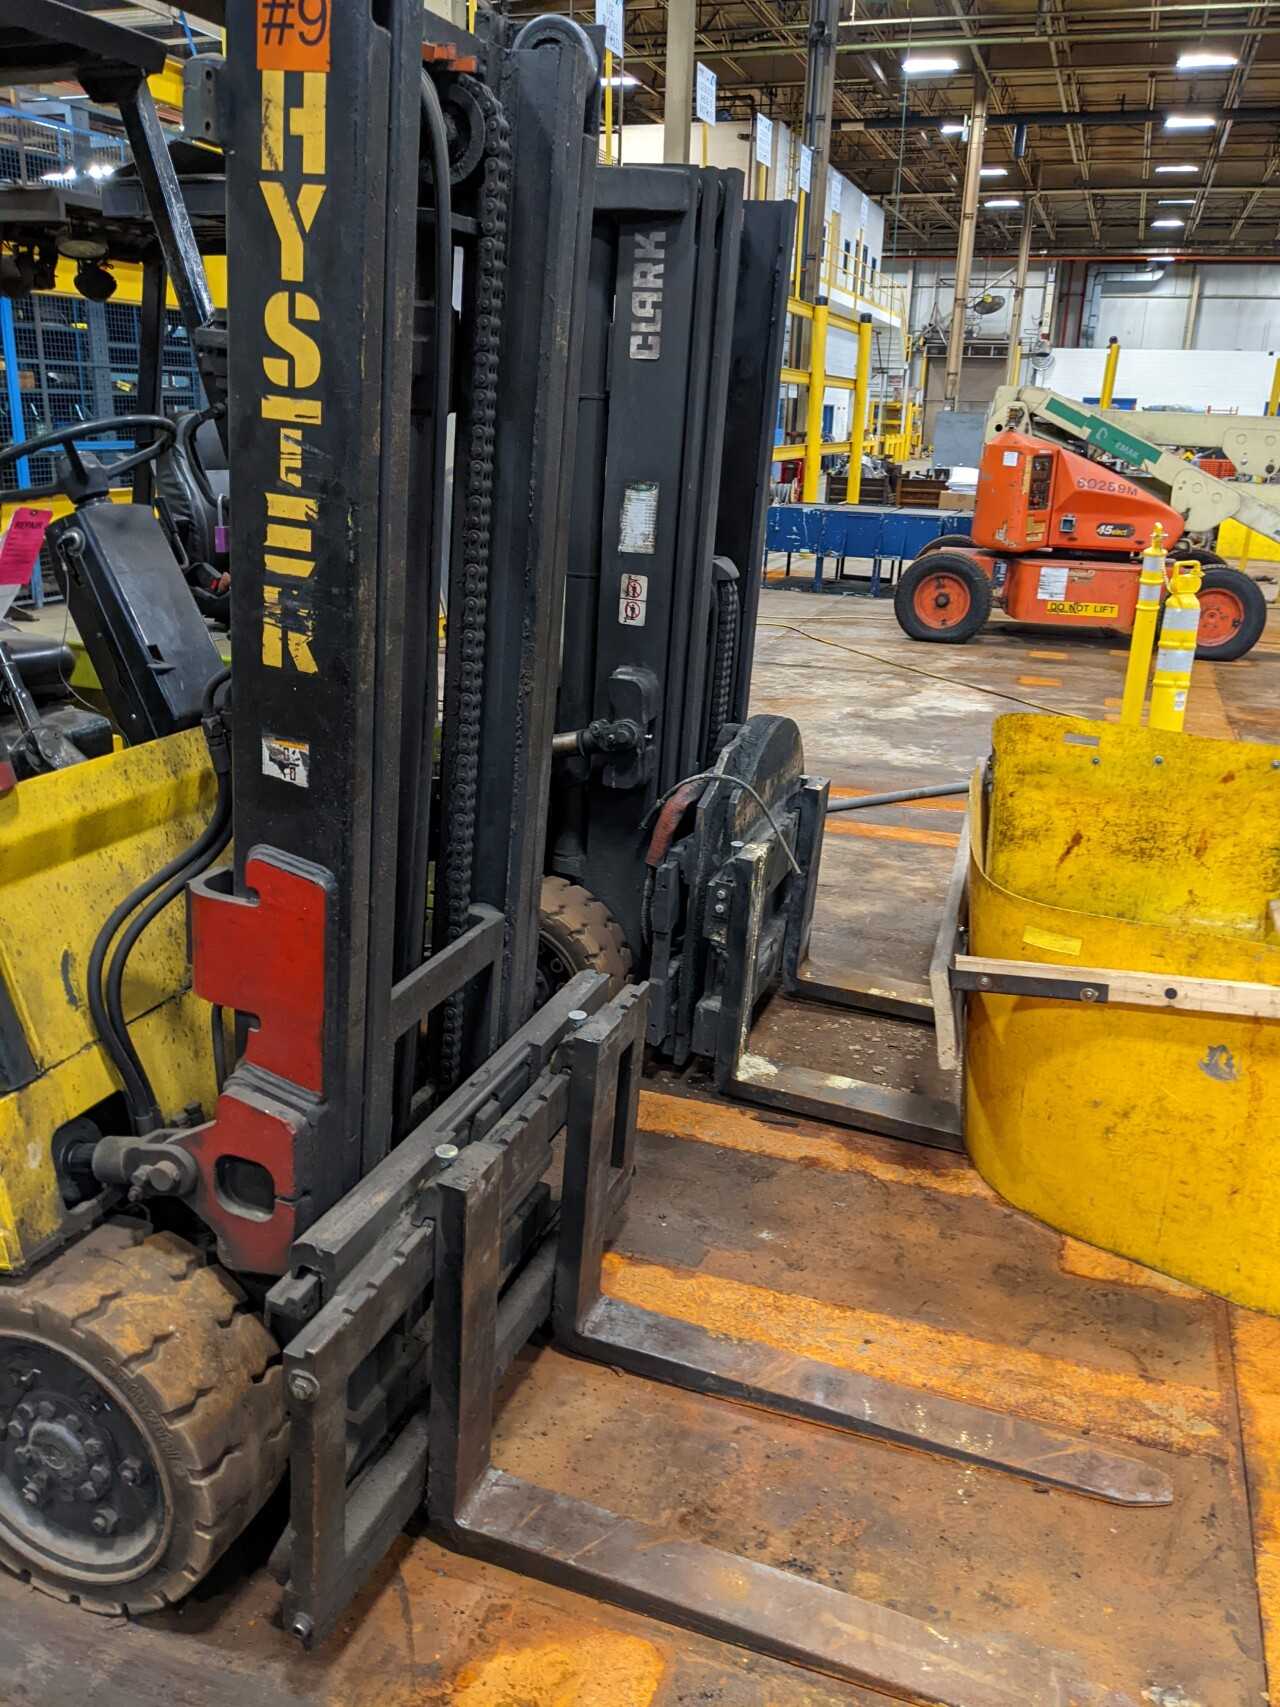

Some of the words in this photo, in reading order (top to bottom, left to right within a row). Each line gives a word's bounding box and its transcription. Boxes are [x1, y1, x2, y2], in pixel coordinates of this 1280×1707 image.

[261, 0, 327, 46] #9
[629, 231, 666, 360] CLARK
[1050, 602, 1064, 613] DO
[1069, 603, 1089, 613] NOT
[1094, 606, 1115, 614] LIFT
